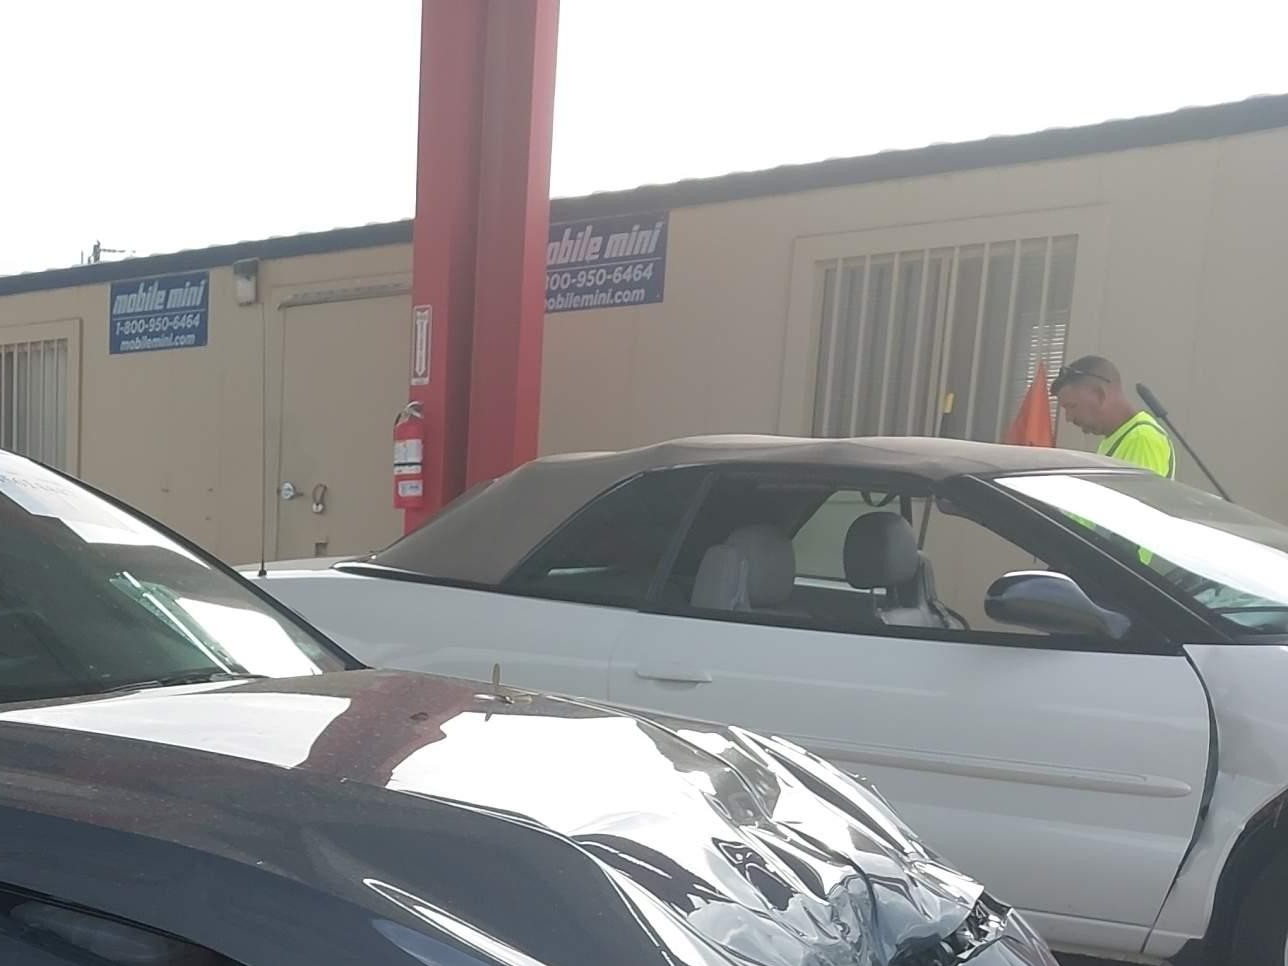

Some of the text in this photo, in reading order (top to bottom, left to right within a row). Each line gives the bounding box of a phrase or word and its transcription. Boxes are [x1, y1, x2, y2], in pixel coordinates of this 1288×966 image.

[546, 221, 664, 266] obile mini
[545, 262, 654, 291] 00-950-6464
[112, 279, 206, 315] mobile mini
[544, 287, 646, 311] obilemini.com
[115, 312, 201, 336] 1-800-950-6464
[119, 332, 196, 352] mobilemini.com
